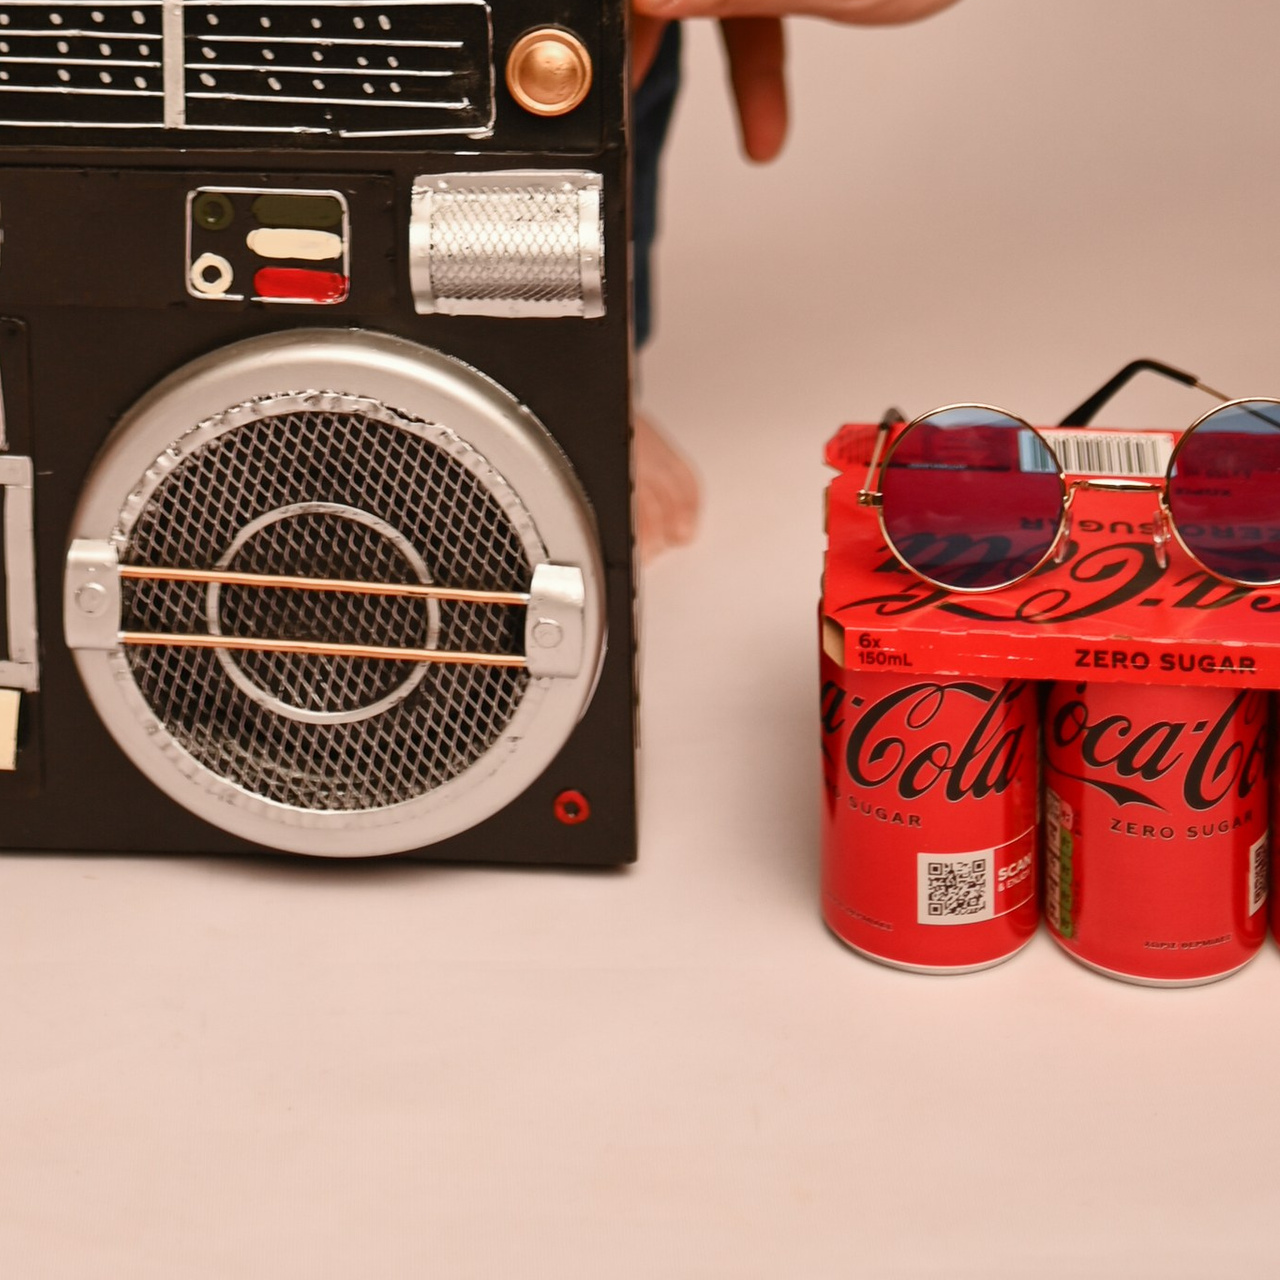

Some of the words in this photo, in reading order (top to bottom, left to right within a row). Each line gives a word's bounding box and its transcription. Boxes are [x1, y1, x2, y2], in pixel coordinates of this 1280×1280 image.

[858, 632, 882, 649] 6x
[858, 651, 913, 667] 150mL
[1075, 649, 1150, 671] ZERO
[1160, 652, 1256, 675] SUGAR
[848, 795, 922, 829] SUGAR
[1110, 817, 1174, 840] ZERO
[1186, 809, 1254, 840] SUGAR
